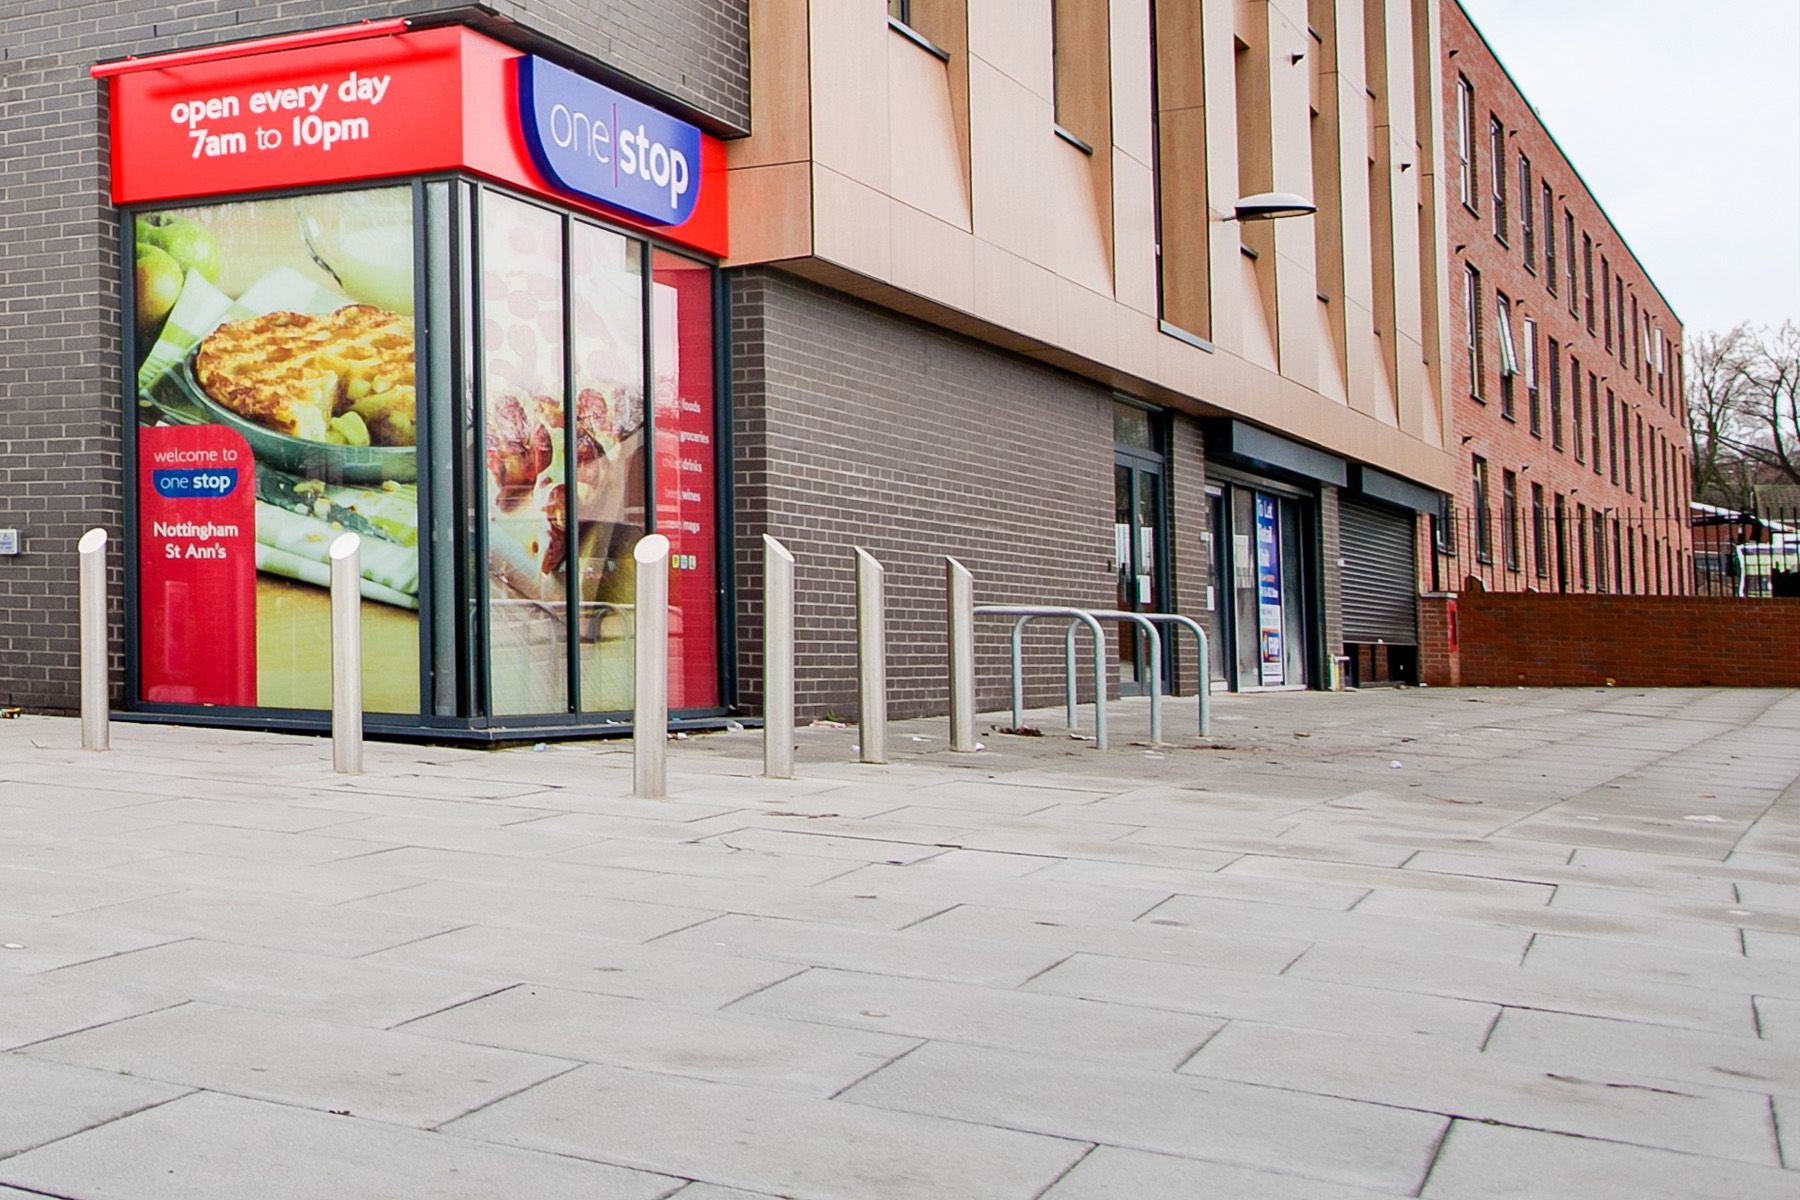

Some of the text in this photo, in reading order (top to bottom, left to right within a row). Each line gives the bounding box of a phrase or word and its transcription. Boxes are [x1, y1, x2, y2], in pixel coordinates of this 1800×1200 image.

[170, 70, 391, 129] open every day
[188, 115, 369, 159] 7am to 10pm
[551, 104, 689, 209] one stop
[153, 447, 238, 463] welcome to
[160, 473, 231, 493] one stop
[153, 521, 238, 540] Nottingham
[165, 543, 226, 559] St Ann's
